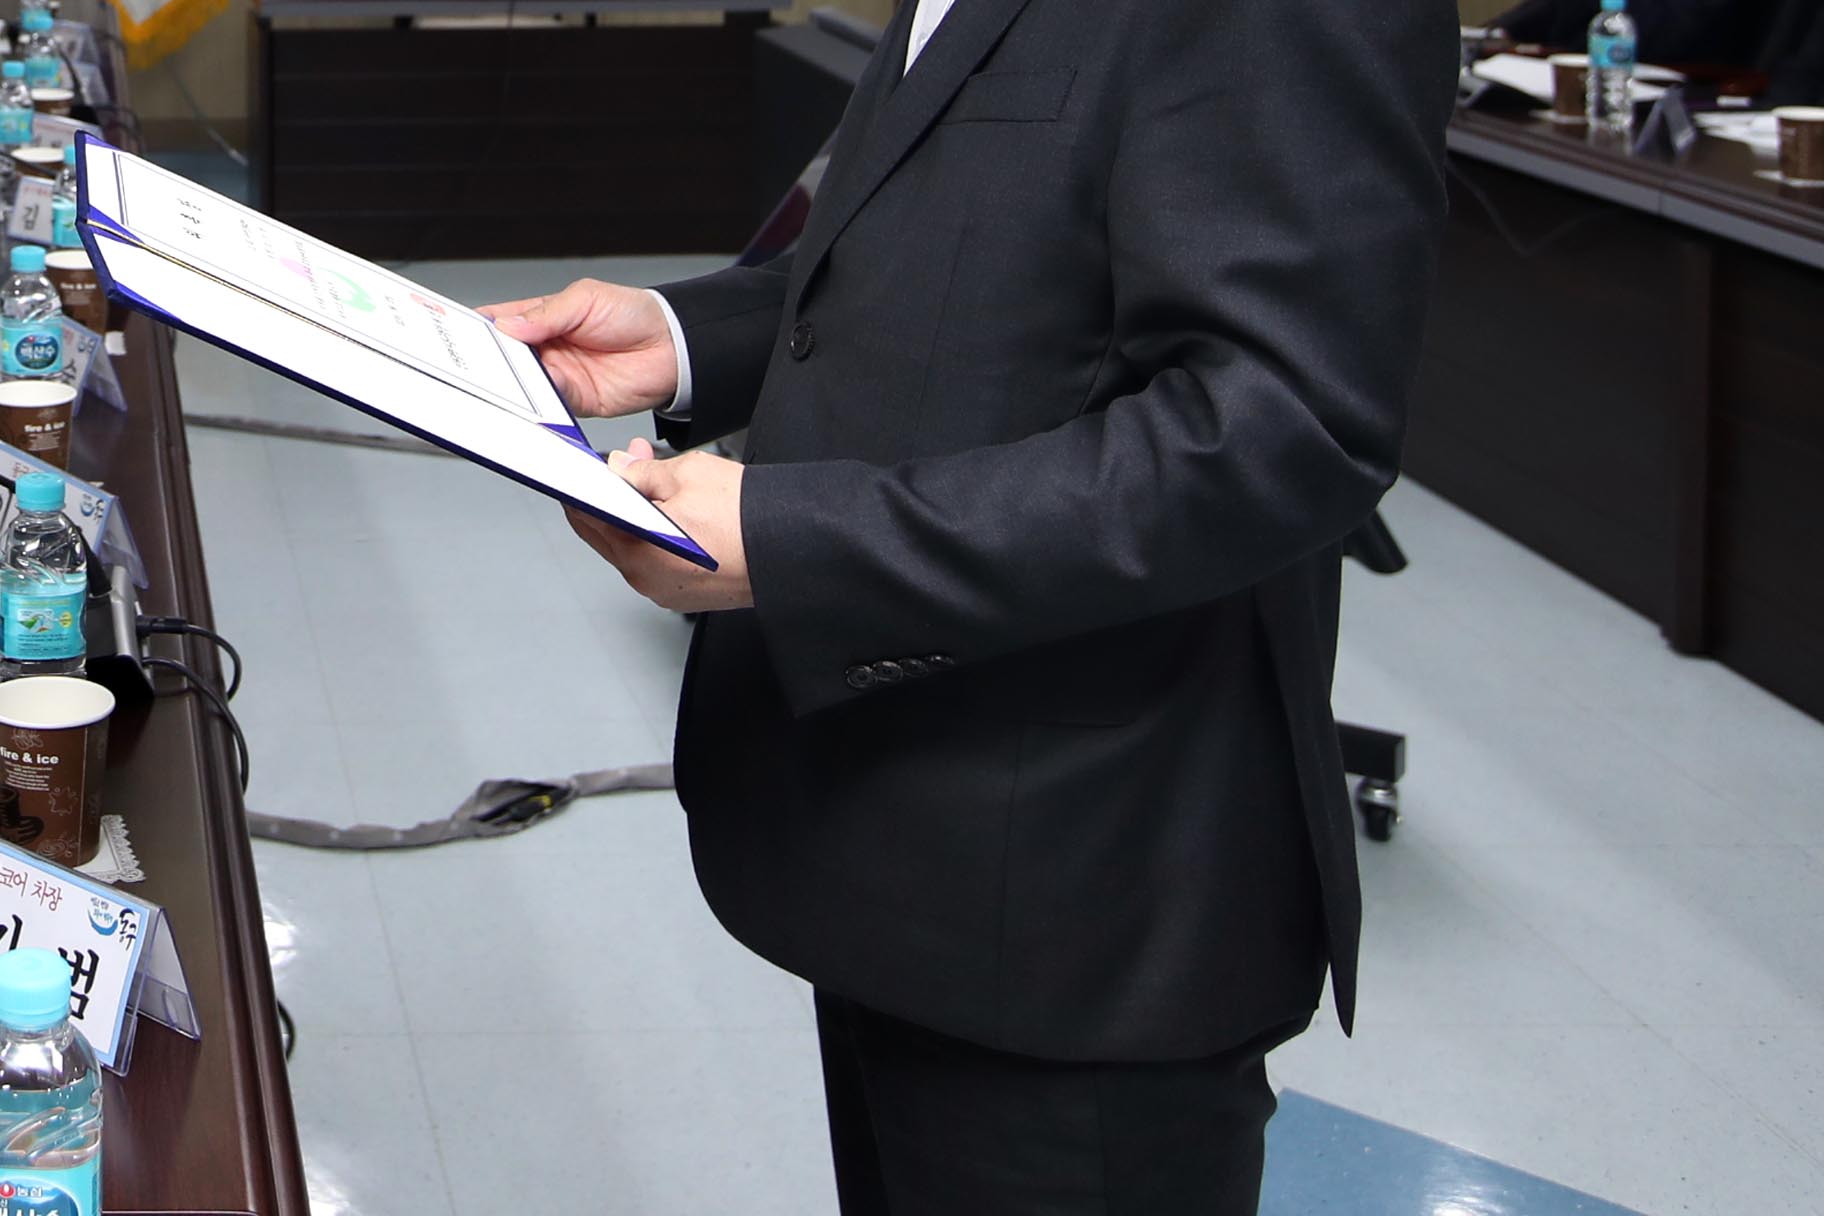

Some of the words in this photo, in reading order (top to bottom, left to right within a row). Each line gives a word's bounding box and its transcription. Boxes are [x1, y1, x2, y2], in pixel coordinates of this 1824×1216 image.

[0, 746, 20, 761] fire
[22, 752, 33, 764] &
[36, 753, 60, 765] ice
[30, 880, 64, 913] 차장
[17, 1186, 43, 1197] 농심
